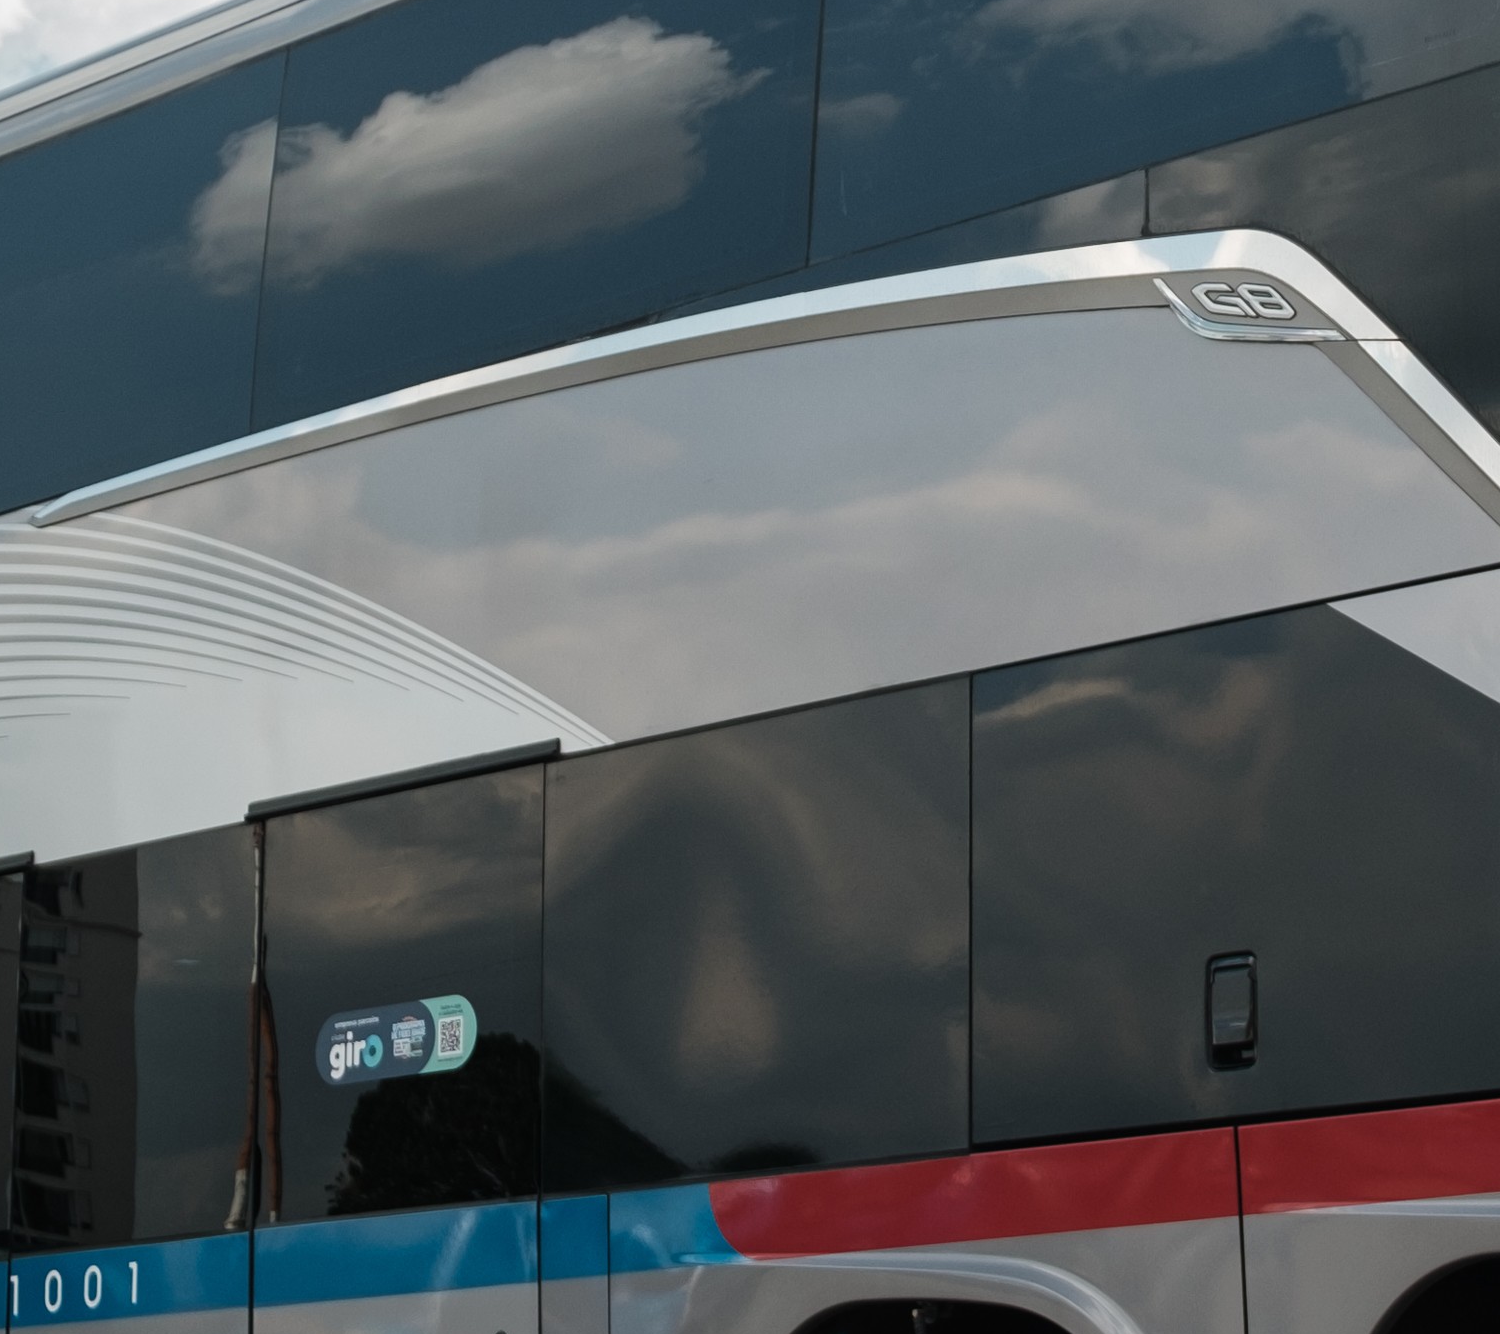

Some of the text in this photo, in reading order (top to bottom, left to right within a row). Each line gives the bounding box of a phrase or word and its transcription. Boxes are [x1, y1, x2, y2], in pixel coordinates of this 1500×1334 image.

[1190, 281, 1297, 321] G8
[329, 1030, 384, 1080] giro
[9, 1261, 140, 1317] 1001
